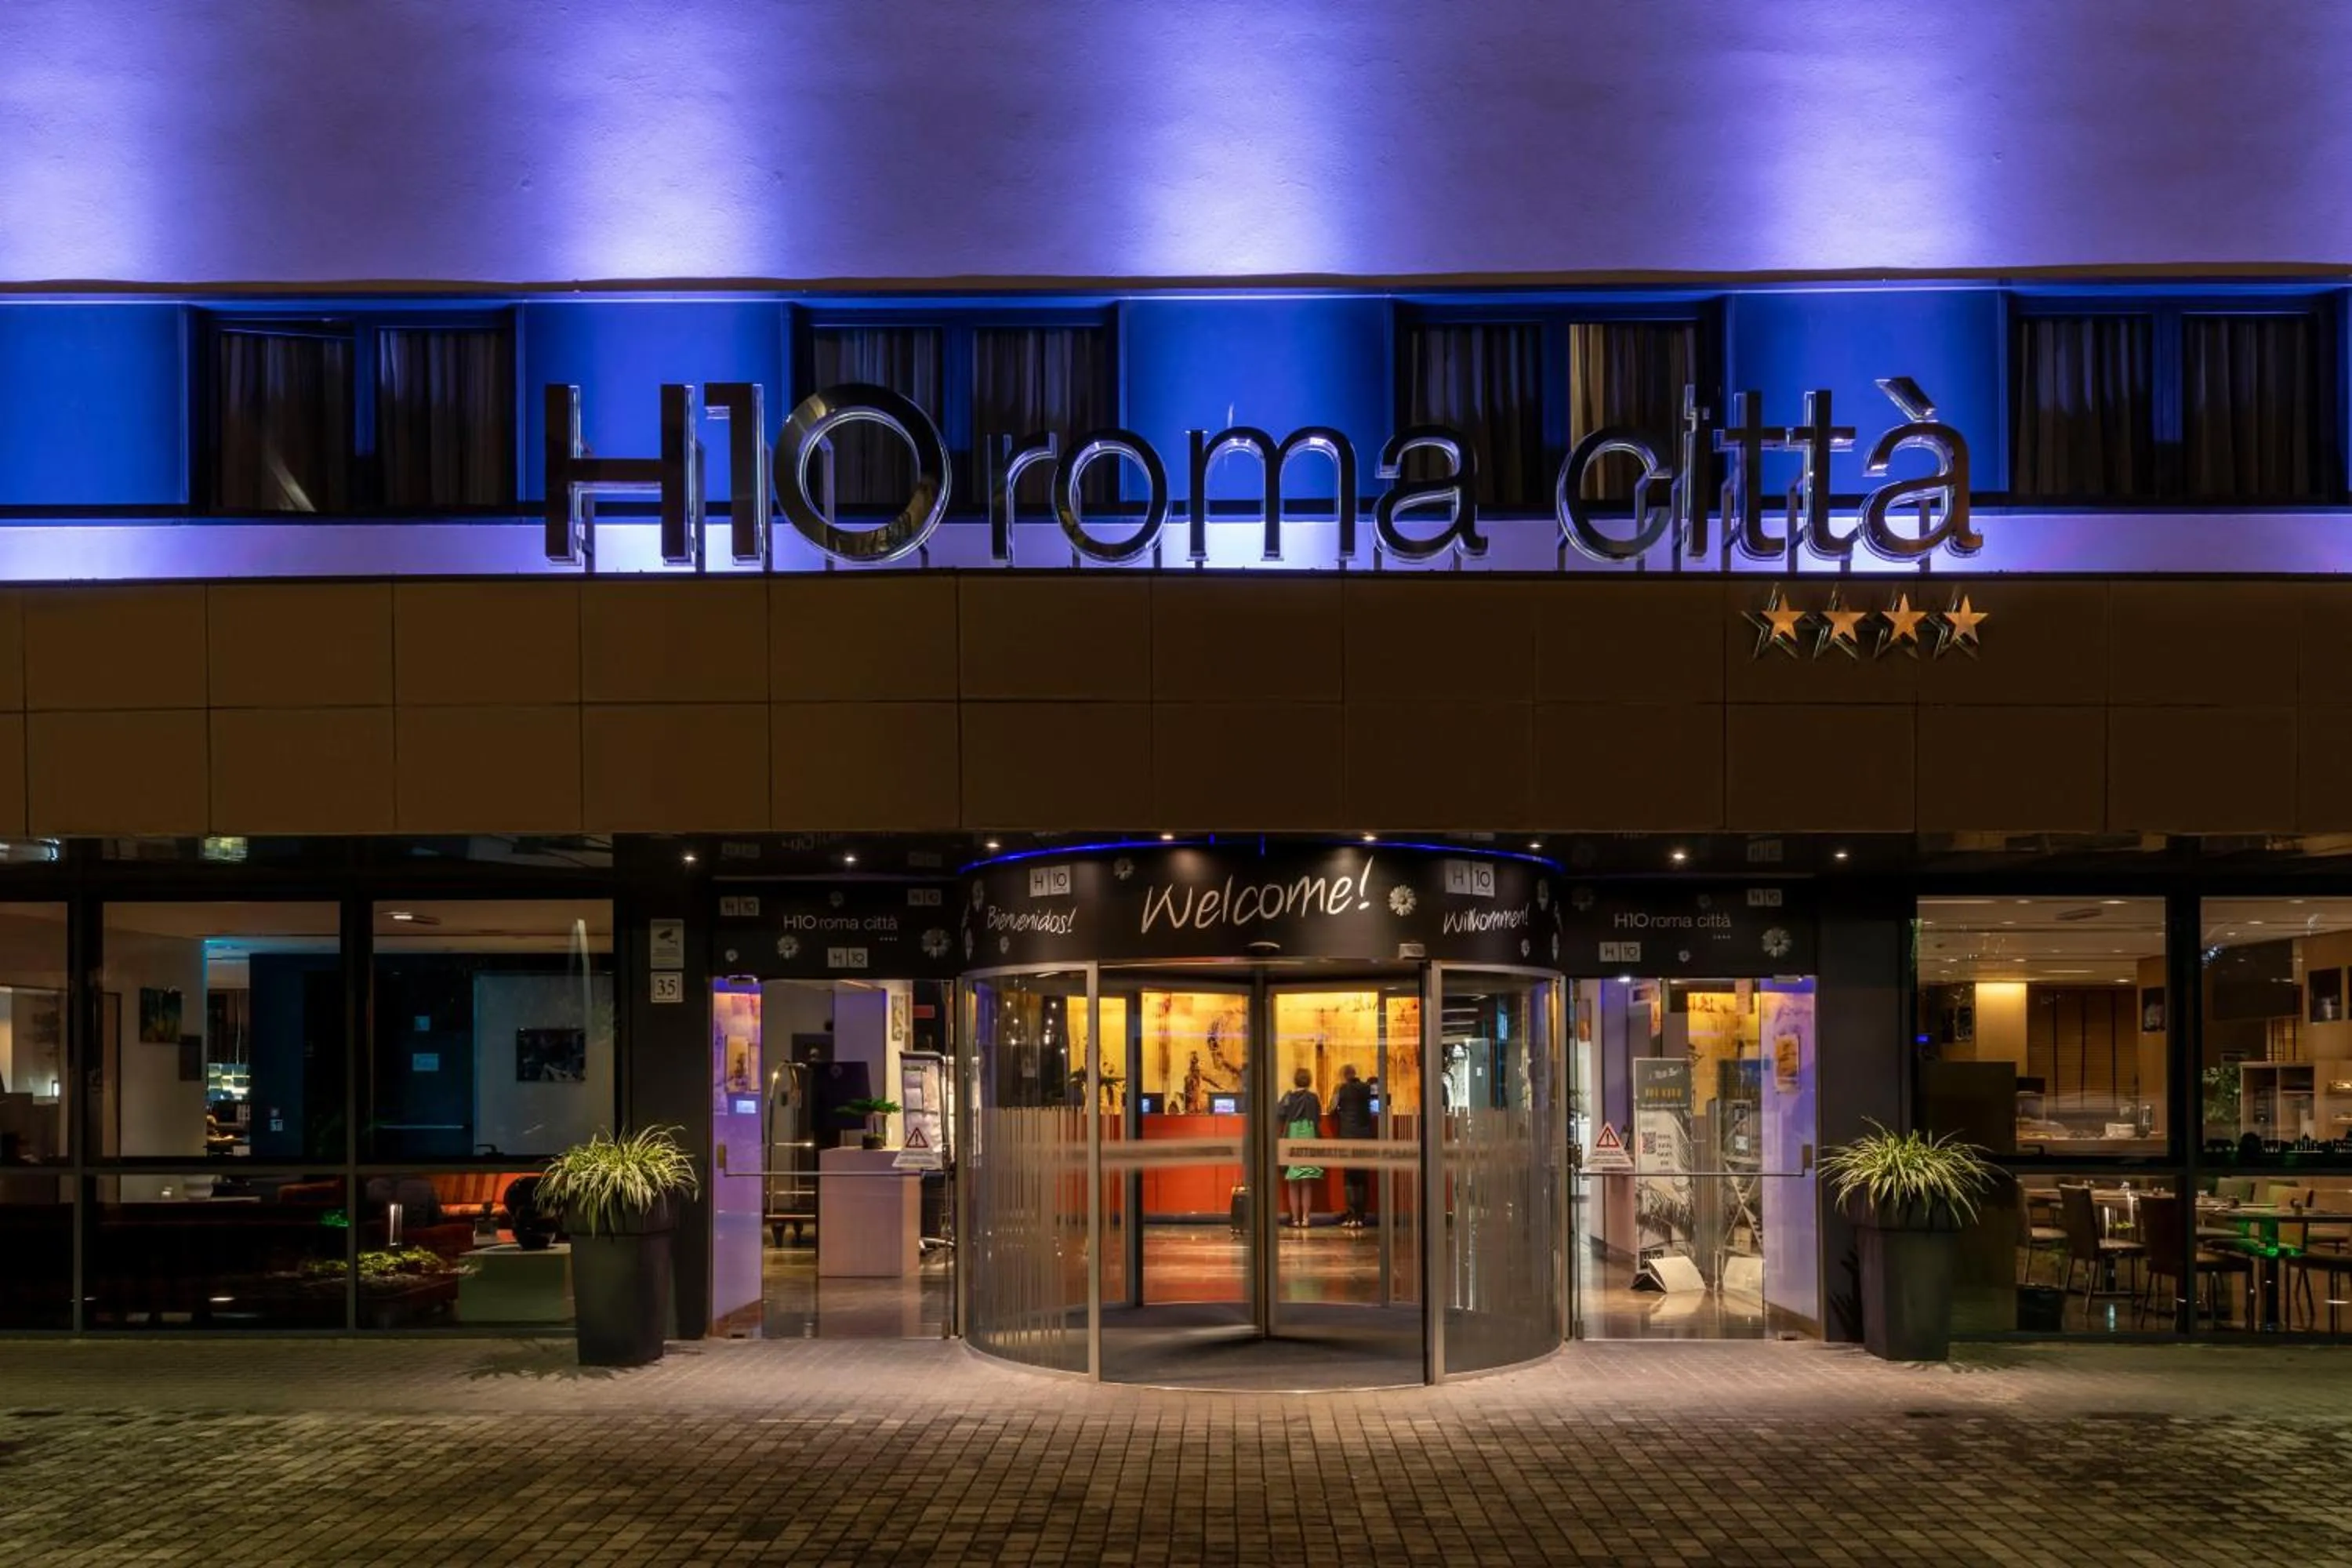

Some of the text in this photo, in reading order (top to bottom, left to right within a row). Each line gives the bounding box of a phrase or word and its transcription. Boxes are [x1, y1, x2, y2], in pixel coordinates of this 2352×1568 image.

[987, 425, 1488, 565] roma
[1557, 376, 1984, 563] città
[1140, 854, 1375, 935] Welcome!
[818, 917, 859, 930] roma
[862, 913, 898, 931] città
[986, 904, 1079, 935] Bienvenidos!
[1443, 902, 1530, 935] Willkommen!
[1650, 916, 1692, 928] roma
[656, 978, 677, 996] 35
